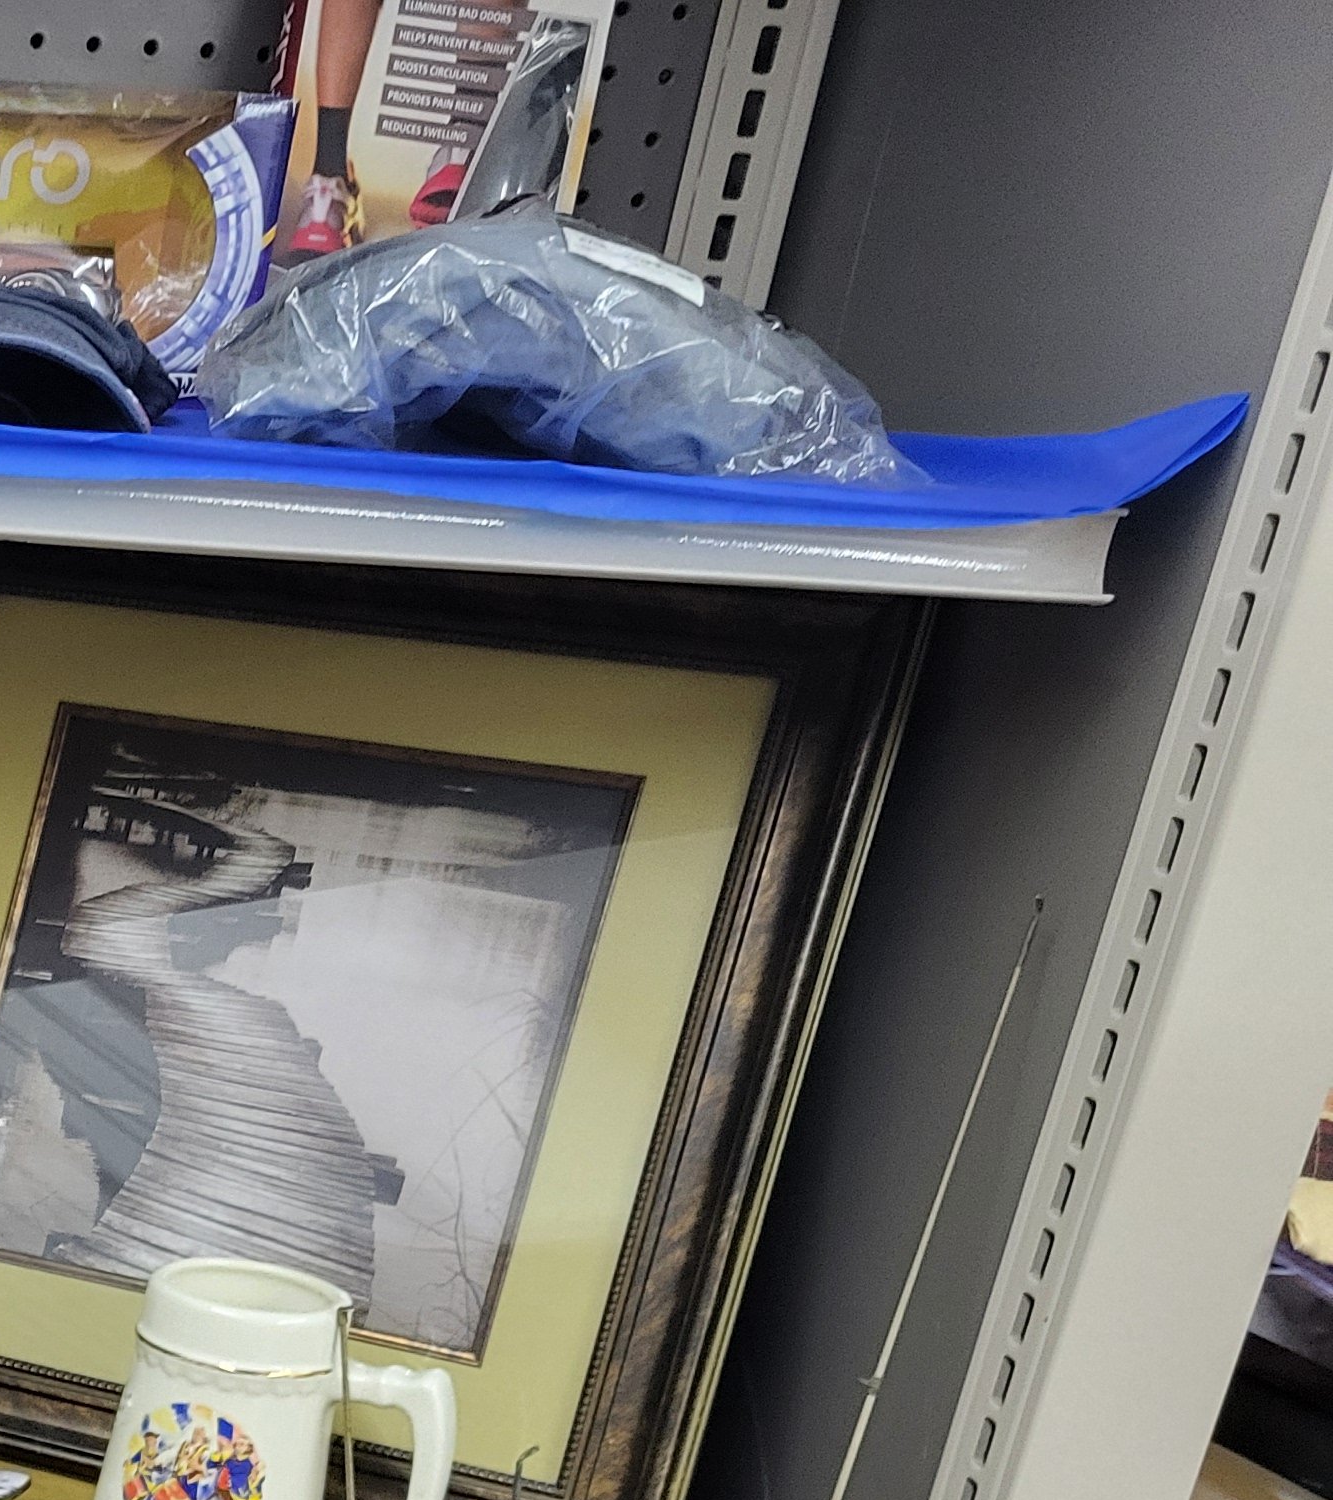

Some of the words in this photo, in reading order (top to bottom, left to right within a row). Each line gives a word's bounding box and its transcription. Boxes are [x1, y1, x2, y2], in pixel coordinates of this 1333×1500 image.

[458, 7, 478, 21] BAD
[480, 11, 512, 25] ODORS
[398, 30, 426, 46] HELPS
[427, 33, 468, 51] PREVENT
[469, 39, 516, 56] RE-INJURY
[393, 60, 428, 76] BOOSTS
[429, 65, 488, 84] CIRCULATION
[387, 90, 431, 107] PROVIDES
[432, 96, 453, 110] PAIN
[454, 99, 484, 115] RELIEF
[381, 120, 422, 137] REDUCES
[423, 126, 468, 143] SWELLING
